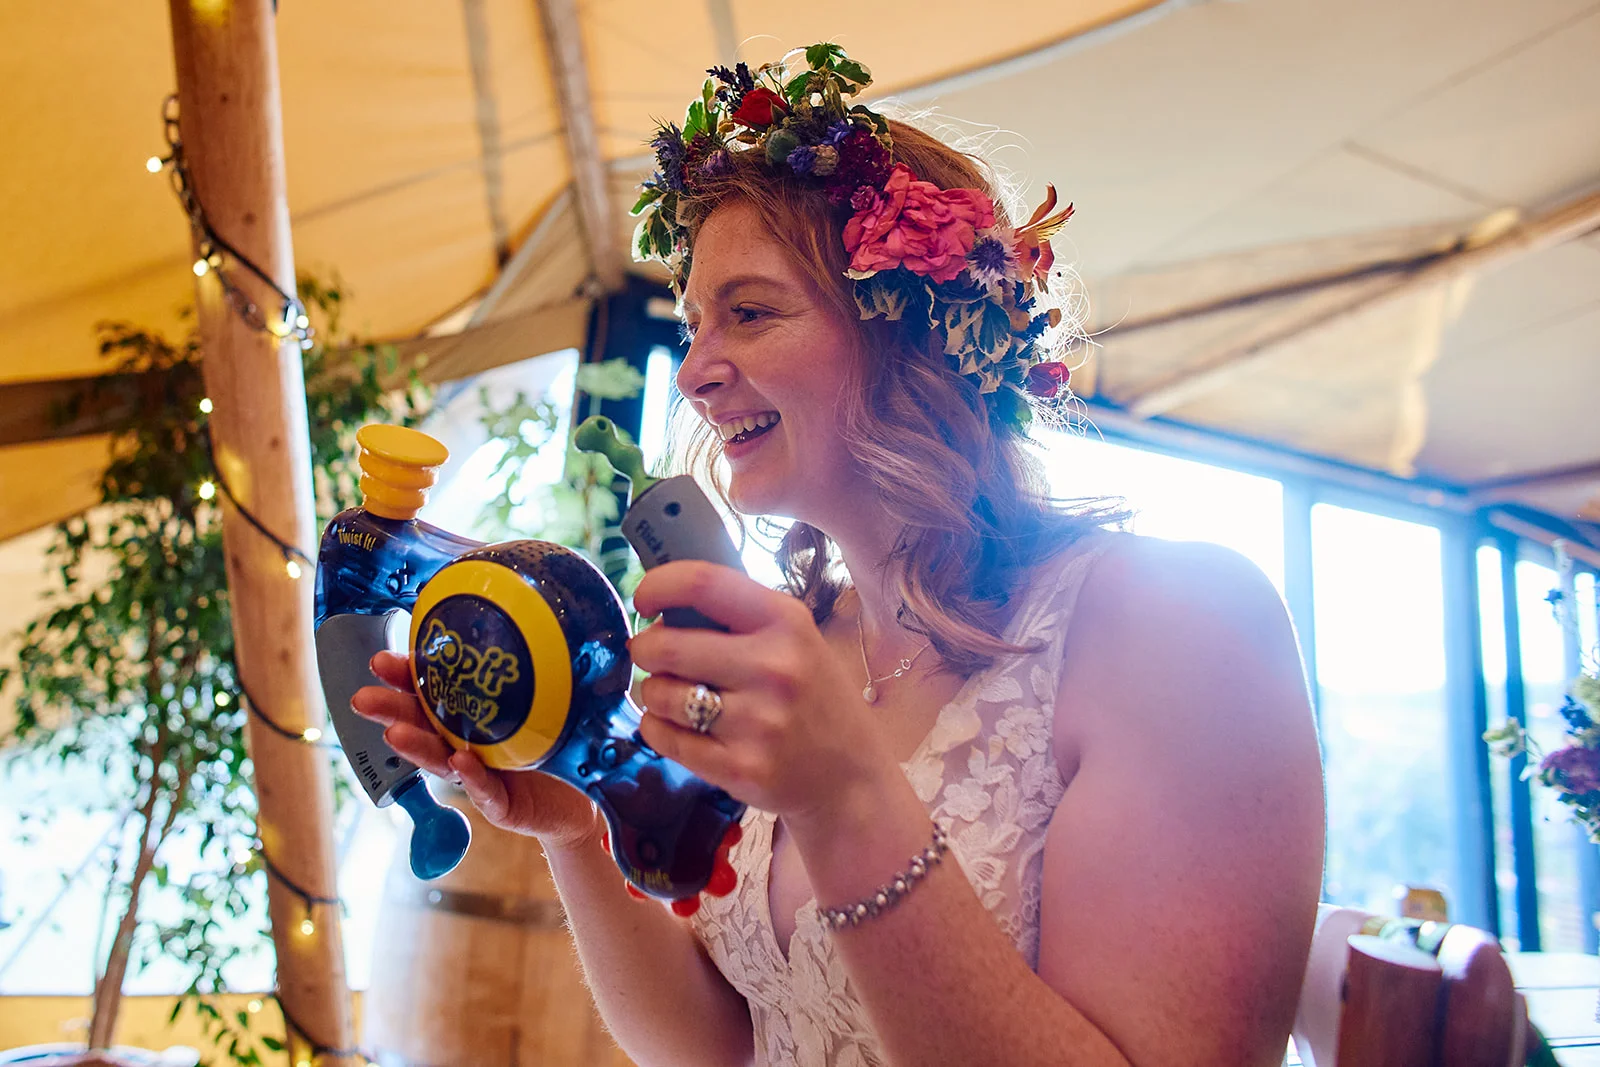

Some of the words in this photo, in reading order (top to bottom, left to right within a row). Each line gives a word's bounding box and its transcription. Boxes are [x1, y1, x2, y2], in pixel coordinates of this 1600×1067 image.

[337, 528, 363, 547] Twist
[363, 532, 377, 552] It!
[474, 699, 502, 735] 2
[355, 750, 369, 766] It!
[362, 765, 382, 791] Pull
